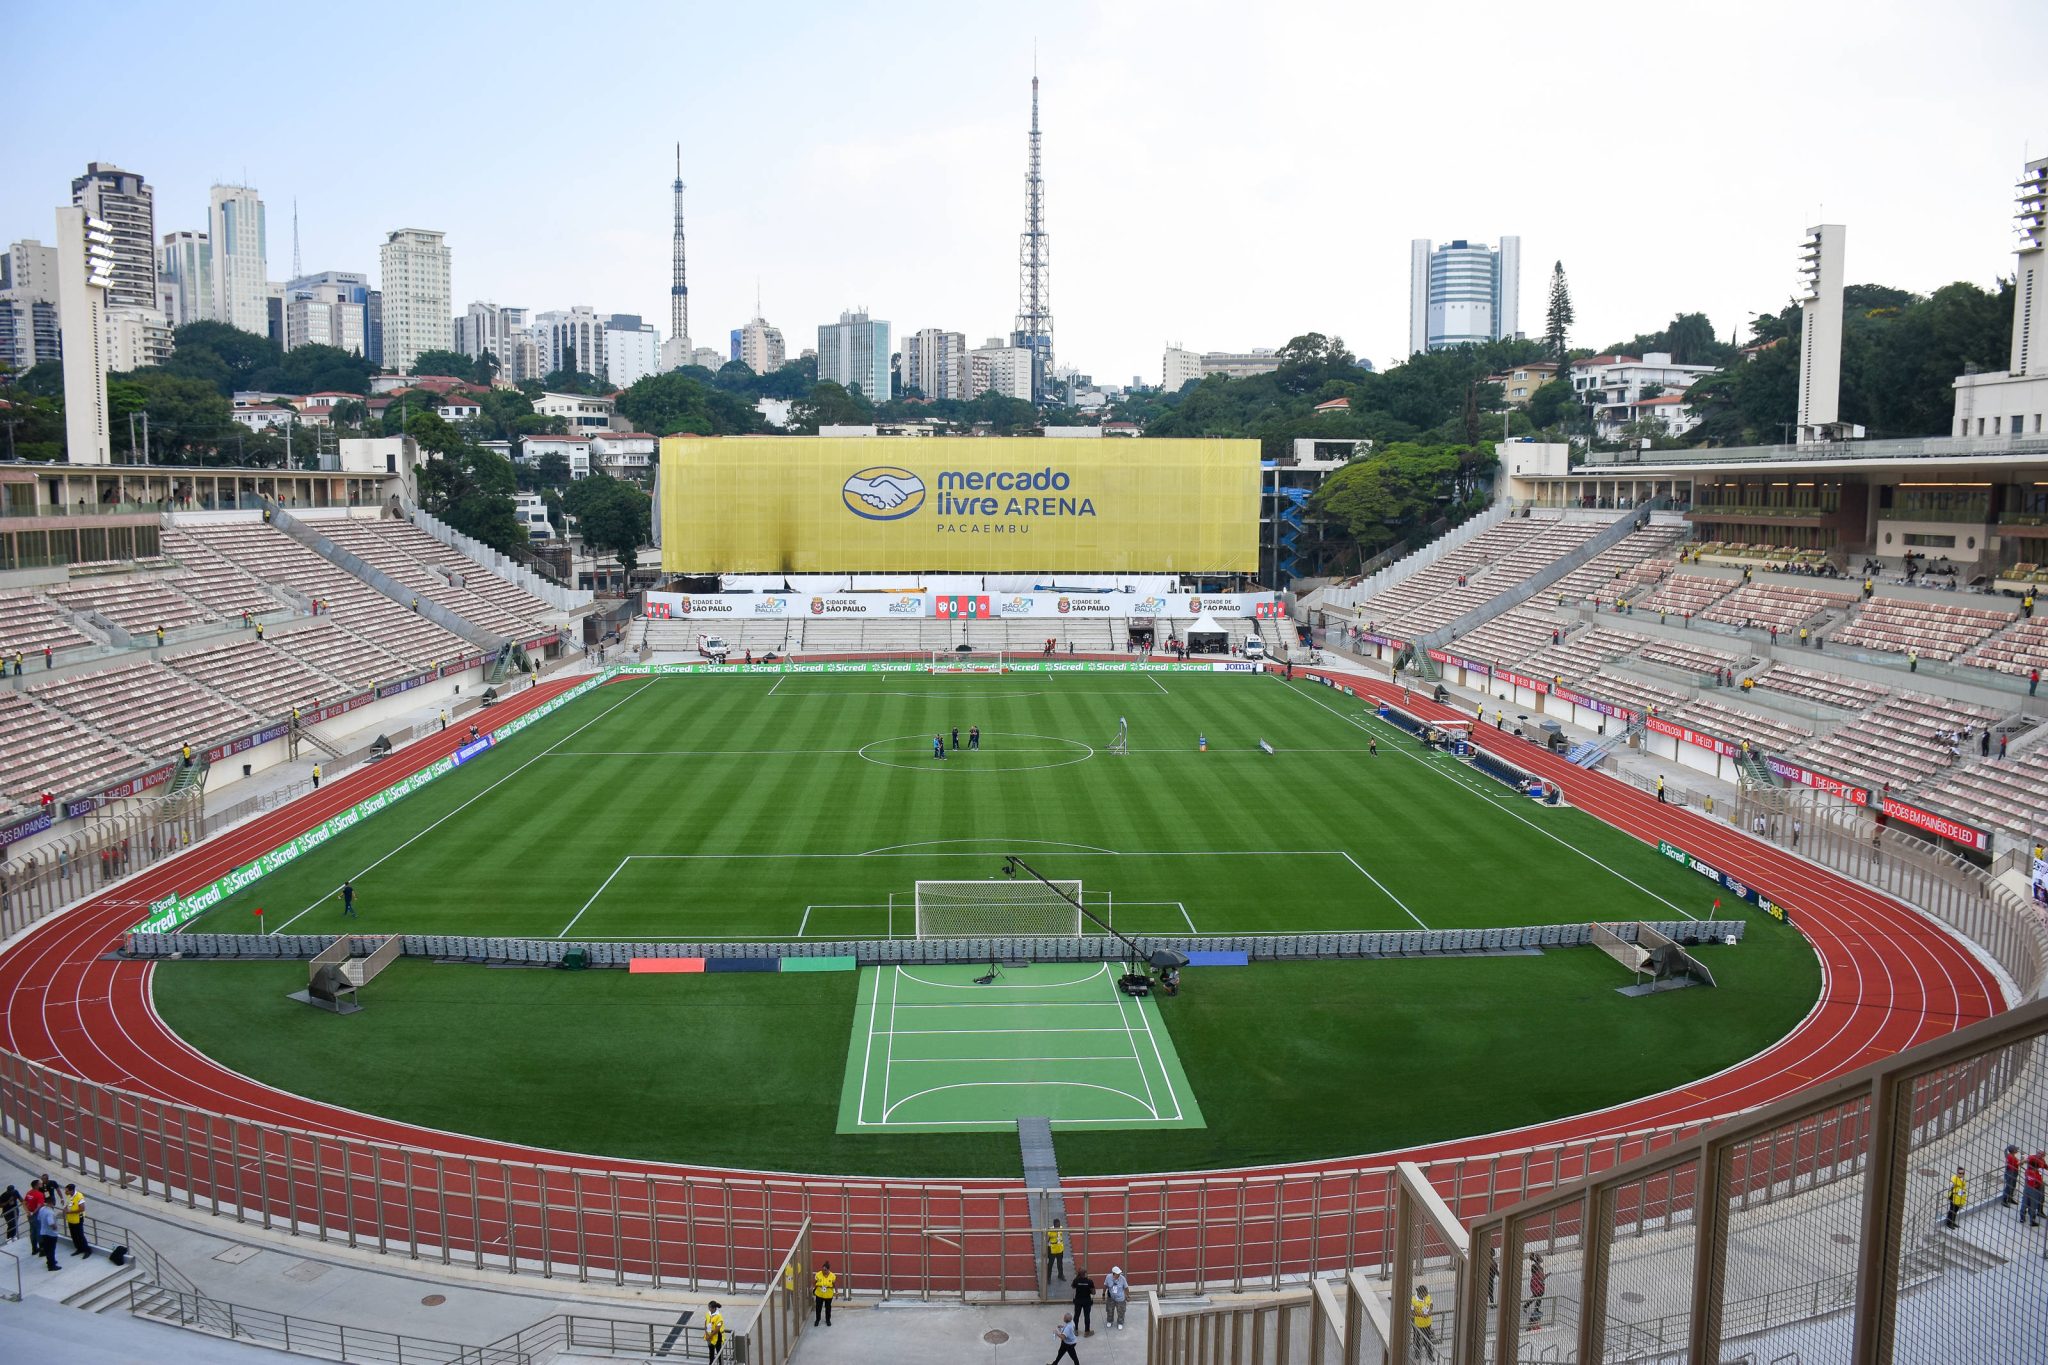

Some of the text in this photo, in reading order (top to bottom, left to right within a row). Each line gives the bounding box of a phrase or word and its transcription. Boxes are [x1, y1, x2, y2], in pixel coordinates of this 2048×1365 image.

[938, 467, 1070, 490] mercado
[938, 492, 1096, 516] livre ARENA
[938, 524, 1029, 534] PACAEMBU
[950, 602, 976, 612] 0 0
[1656, 722, 1682, 737] TECNOLOGIA
[234, 741, 242, 752] THE
[1703, 738, 1712, 748] LED
[436, 757, 454, 774] Sicredi
[414, 768, 432, 786] Sicredi
[1815, 776, 1837, 793] THE LED
[120, 784, 130, 797] LED
[391, 780, 410, 800] Sicredi
[1856, 792, 1866, 803] SO
[70, 800, 90, 817] DE LED
[365, 794, 386, 814] Sicredi
[13, 826, 24, 839] EM
[24, 814, 50, 835] PAINÉIS
[335, 808, 358, 830] Sicredi
[1883, 801, 1972, 842] LUÇÕES EM PAINÉIS DE LED
[305, 825, 330, 848] Sicredi
[271, 842, 299, 867] Sicredi
[1666, 846, 1685, 864] Sicredi
[232, 862, 262, 889] Sicredi
[157, 893, 176, 912] Sicredi
[187, 884, 222, 915] Sicredi
[1759, 894, 1783, 920] bet365
[141, 909, 177, 933] Sicredi
